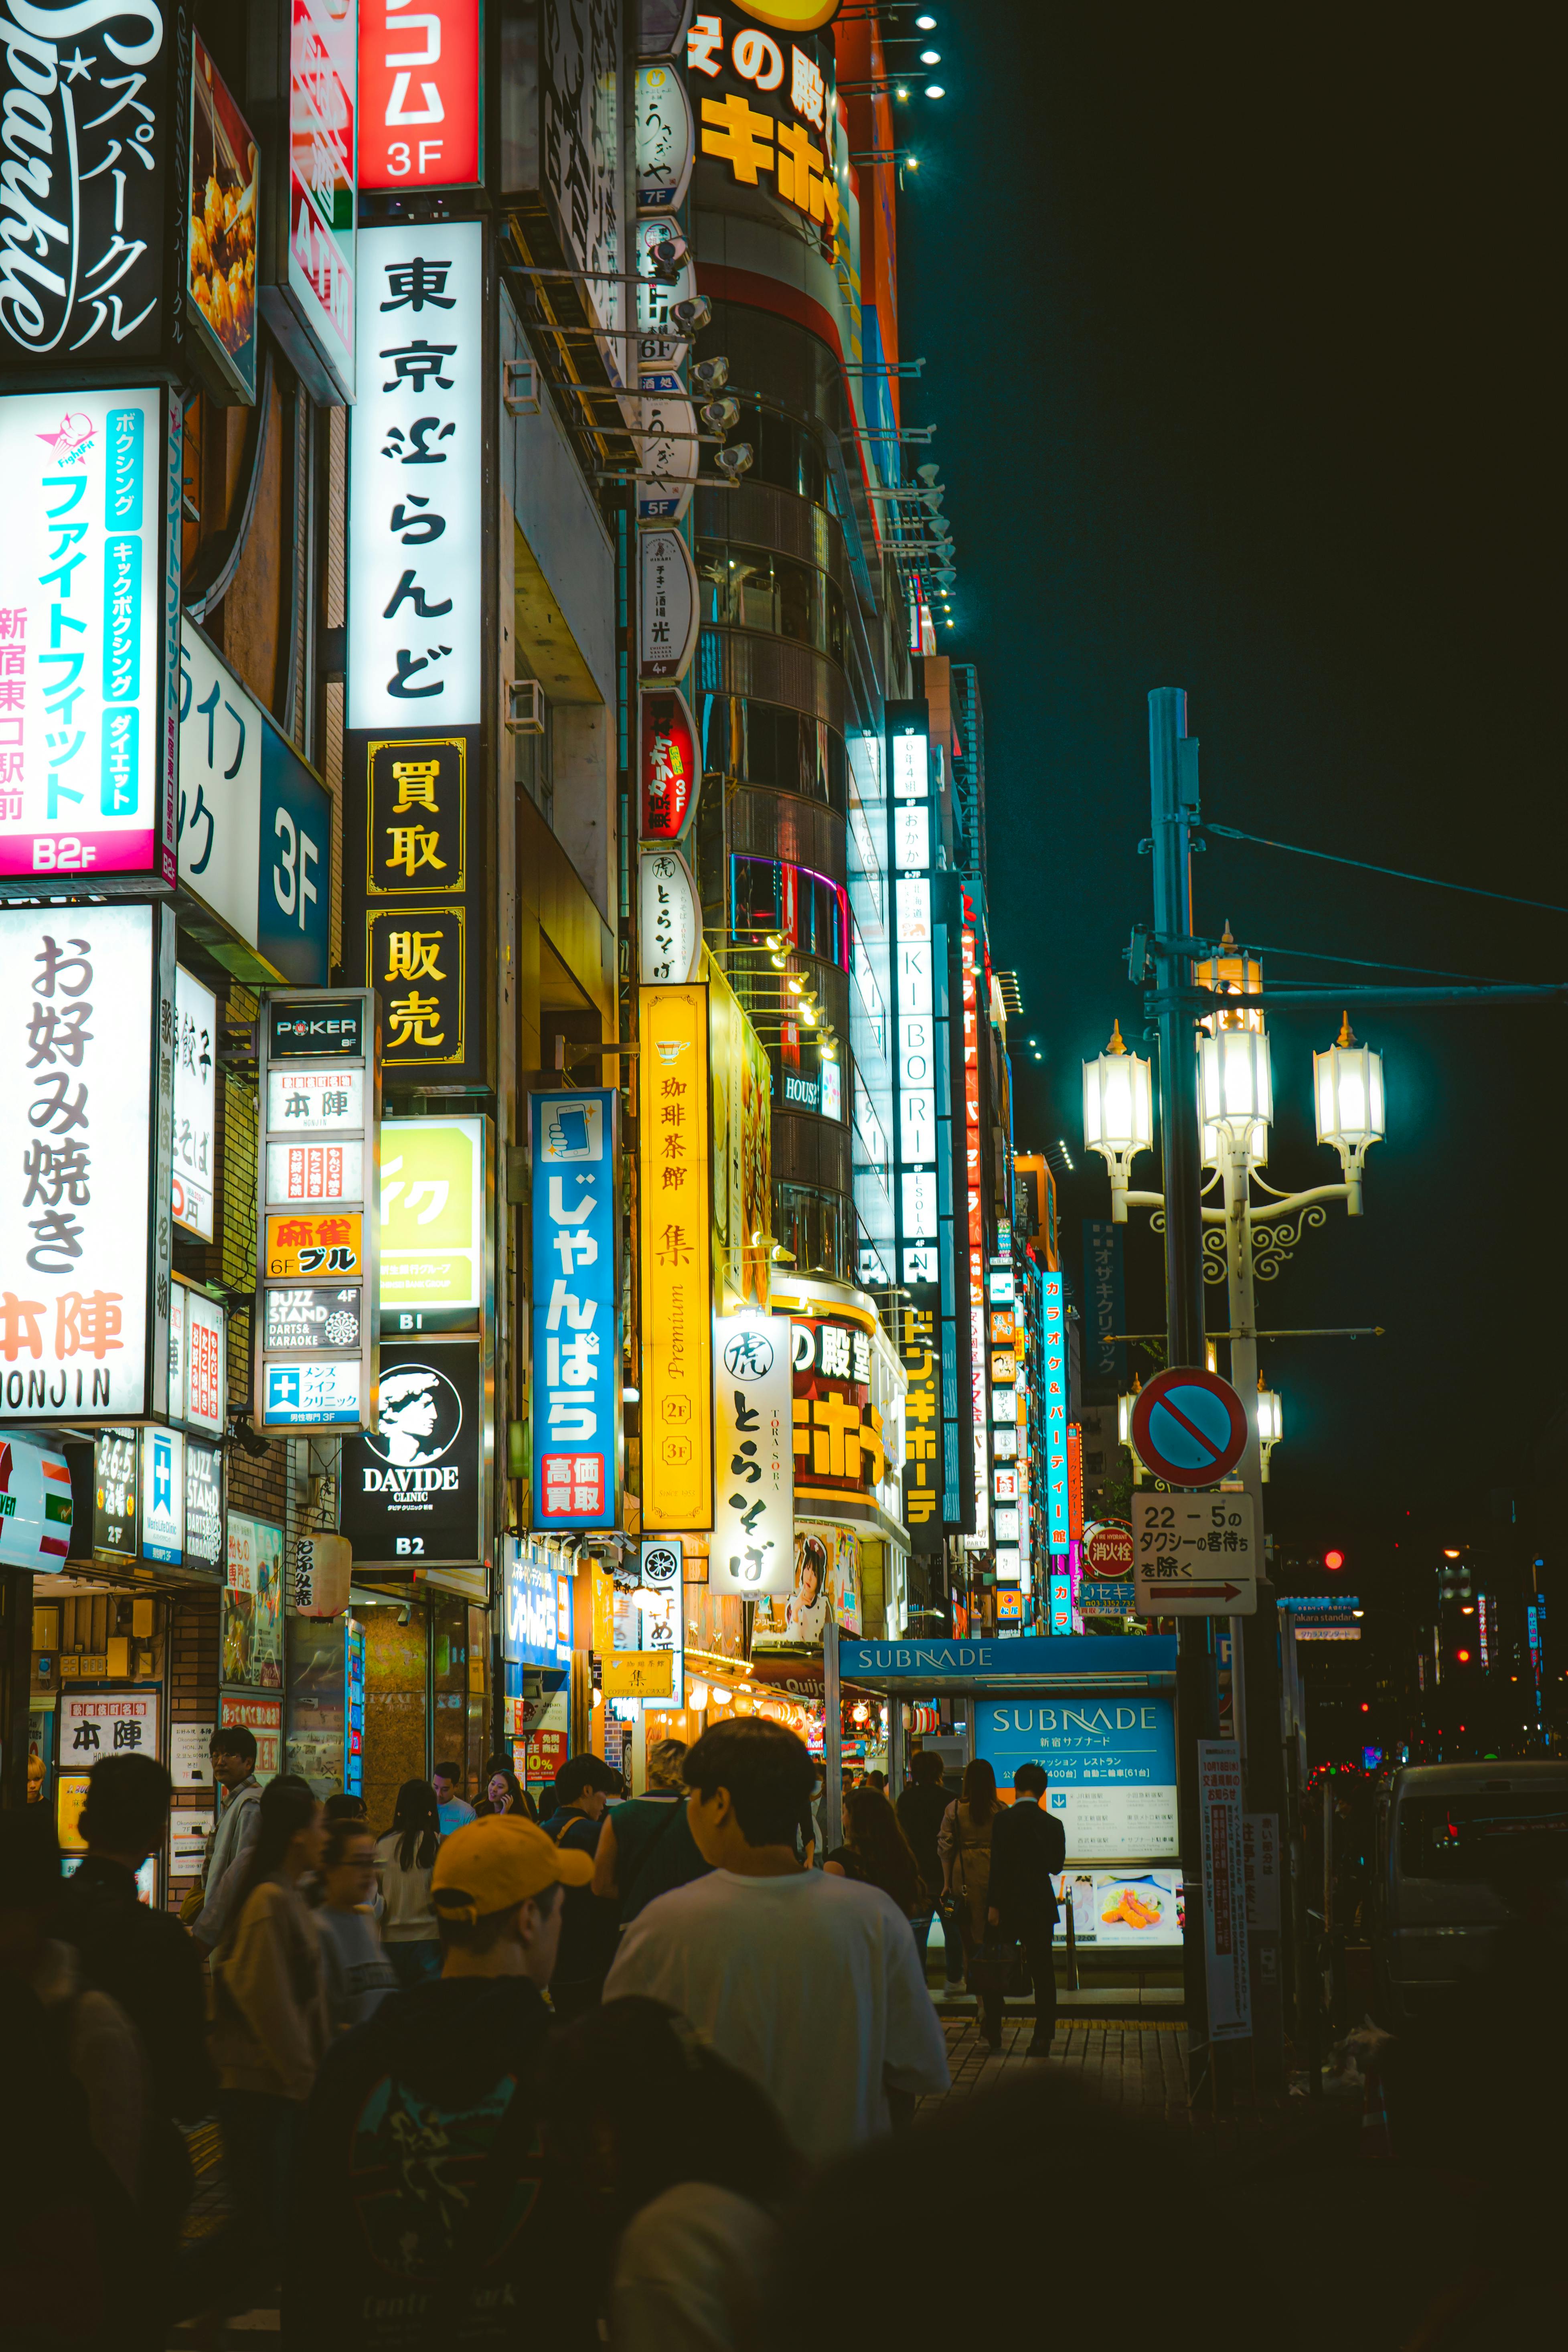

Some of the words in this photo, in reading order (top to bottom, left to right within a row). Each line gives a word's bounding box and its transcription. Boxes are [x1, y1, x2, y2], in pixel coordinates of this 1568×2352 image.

[385, 0, 445, 126] コム
[387, 140, 443, 176] 3F
[646, 191, 666, 203] 7F
[70, 73, 157, 350] スパークル
[296, 198, 348, 341] ATM
[642, 340, 670, 358] 6F
[643, 376, 673, 389] 酒処
[57, 440, 95, 468] FightFit
[114, 413, 136, 517] ボクシング
[648, 501, 669, 515] 5F
[656, 565, 666, 617] チキン酒場
[111, 542, 134, 698] キックボクシング
[652, 621, 670, 642] 光
[38, 475, 89, 820] ファイトフィット
[652, 662, 667, 674] 4F
[109, 715, 132, 810] ダイエット
[904, 741, 916, 793] 6年4組
[676, 779, 686, 812] 3F
[386, 760, 447, 877] 買取
[906, 814, 919, 863] おかか
[32, 837, 97, 871] B2F
[273, 807, 318, 931] 3F
[913, 883, 922, 919] 北海道
[654, 885, 675, 979] とらそば
[385, 930, 447, 1047] 販売
[905, 951, 926, 1153] KIBORI
[22, 935, 94, 1274] お好み焼き
[284, 1090, 348, 1118] 本陣
[290, 1149, 302, 1197] お好み焼
[309, 1149, 321, 1196] たこ焼き
[328, 1149, 340, 1197] もんじゃ焼き
[916, 1175, 924, 1235] ESOLA
[277, 1219, 351, 1247] 麻雀
[655, 1224, 695, 1267] 集
[271, 1259, 295, 1274] 6F
[298, 1247, 357, 1273] ブル
[270, 1290, 314, 1308] BUZZ
[337, 1289, 357, 1302] 4F
[546, 1173, 600, 1442] じゃんぱら
[269, 1306, 328, 1323] STAND
[399, 1314, 423, 1330] B1
[269, 1324, 310, 1335] DARTS&
[269, 1335, 318, 1346] KARAOKE
[668, 1284, 685, 1379] Premium
[303, 1366, 336, 1378] メンズ
[0, 1368, 110, 1409] ONJIN
[303, 1381, 335, 1392] ライフ
[303, 1396, 357, 1408] クリニック
[667, 1403, 687, 1418] 2F
[1046, 1281, 1067, 1544] カラオケ&パーティー館
[290, 1413, 321, 1422] 男性専門
[323, 1412, 335, 1422] 3F
[770, 1409, 780, 1446] TORA
[188, 1447, 212, 1483] BUZZ
[213, 1449, 222, 1467] 4F
[667, 1444, 687, 1459] 3F
[363, 1466, 458, 1493] DAVIDE
[546, 1457, 601, 1486] 高価
[771, 1453, 780, 1491] SOBA
[393, 1493, 428, 1503] CLINIC
[728, 1390, 775, 1581] とらそば
[546, 1486, 601, 1513] 買取
[107, 1525, 123, 1544] 2F
[396, 1538, 425, 1556] B2
[1140, 1531, 1248, 1552] タクシーの客待ち
[1093, 1542, 1132, 1561] 消火栓
[1141, 1556, 1193, 1578] を除く
[1000, 1606, 1019, 1615] 松屋
[1054, 1586, 1068, 1626] カラ
[859, 1647, 993, 1670] SUBNADE
[628, 1669, 647, 1687] 集
[71, 1703, 146, 1716] 歌舞伎町名物
[993, 1707, 1157, 1734] SUBNADE
[73, 1720, 143, 1750] 本陣
[542, 1734, 560, 1743] 免税
[1040, 1736, 1110, 1748] 新宿サブナード
[542, 1744, 560, 1754] 商店
[1031, 1758, 1077, 1767] ファッション
[1084, 1757, 1122, 1766] レストラン
[1207, 1789, 1236, 1801] お知らせ
